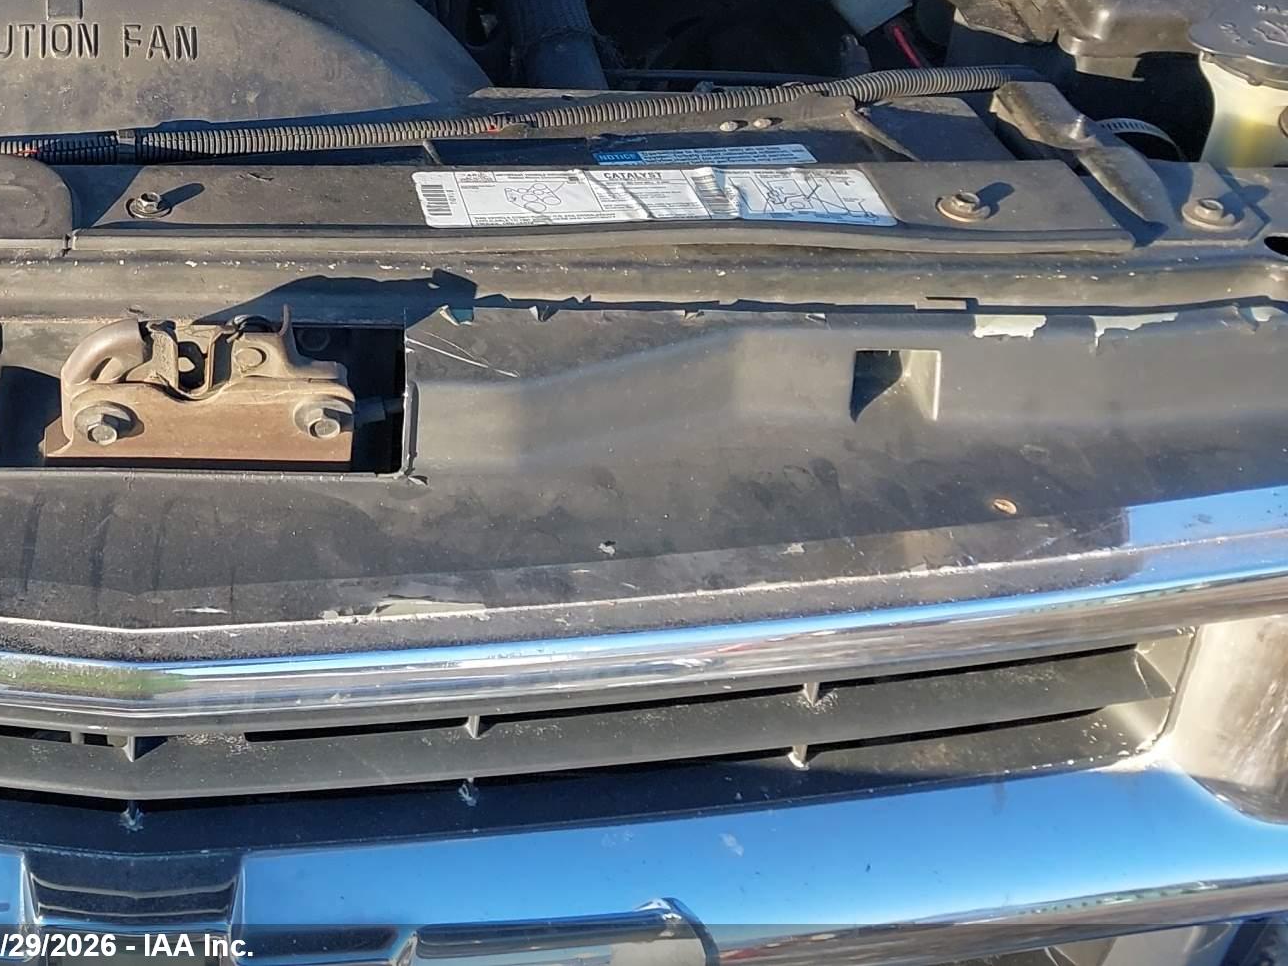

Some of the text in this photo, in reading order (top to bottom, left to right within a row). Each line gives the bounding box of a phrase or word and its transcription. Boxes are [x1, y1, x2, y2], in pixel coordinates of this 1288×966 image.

[122, 24, 200, 61] FAN
[598, 153, 636, 161] NOTICE
[603, 171, 663, 180] CATALYST
